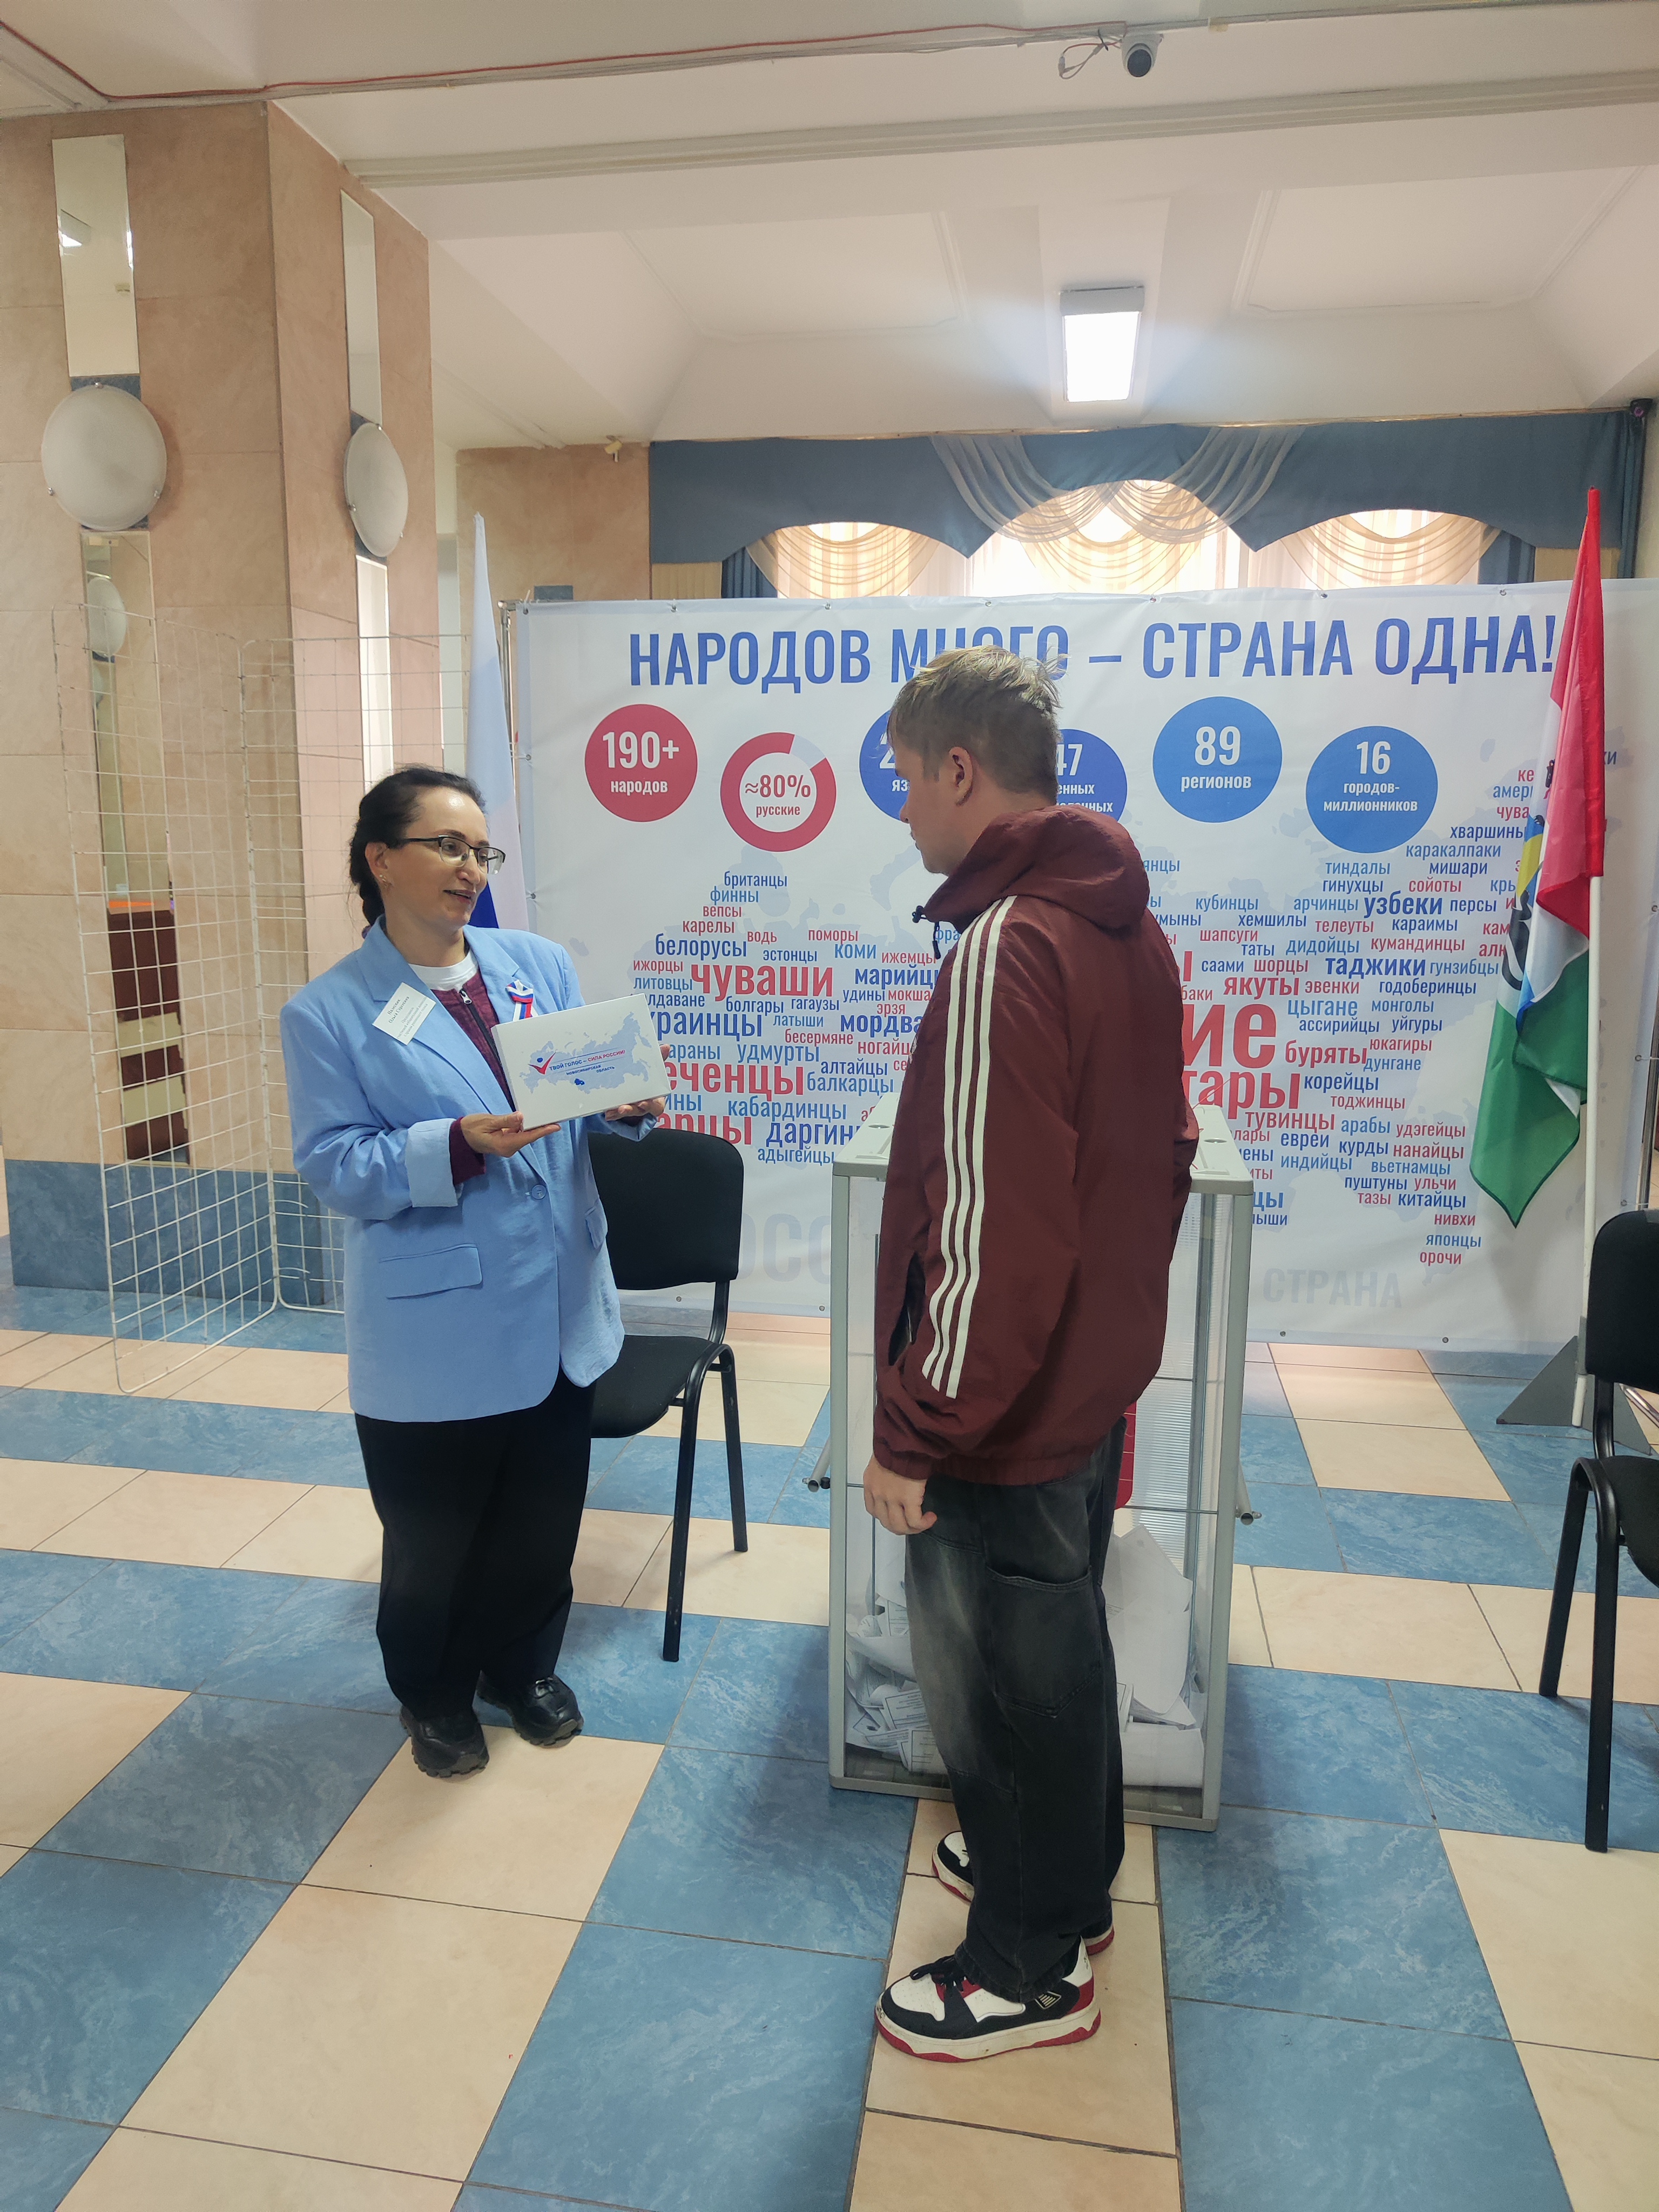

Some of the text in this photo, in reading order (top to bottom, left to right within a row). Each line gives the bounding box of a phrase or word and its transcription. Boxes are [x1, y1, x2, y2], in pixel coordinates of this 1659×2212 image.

[630, 630, 871, 693] НАРОДОВ
[1143, 619, 1353, 679] СТРАНА
[1375, 615, 1556, 685] ОДНА!
[603, 731, 679, 769] 190+
[1195, 726, 1241, 766] 89
[1356, 741, 1391, 774] 16
[611, 779, 668, 795] народов
[1057, 784, 1095, 795] енных
[1181, 773, 1252, 792] регионов
[1343, 782, 1400, 797] городов-
[756, 803, 800, 818] русские
[1323, 799, 1418, 813] миллионников
[1497, 806, 1529, 821] чува
[1406, 845, 1501, 860] каракалпаки
[1326, 862, 1391, 877] тиндалы
[1429, 862, 1487, 878] мишари
[724, 871, 787, 889] британцы
[1323, 880, 1384, 894] гинухцы
[1408, 876, 1462, 892] сойоты
[710, 886, 759, 905] финны
[1196, 894, 1258, 913] кубинцы
[703, 906, 742, 917] вепсы
[1293, 898, 1358, 913] арчинцы
[1364, 891, 1442, 918] узбеки
[1450, 899, 1496, 915] персы
[683, 920, 735, 936] карелы
[1238, 914, 1306, 927] хемшилы
[1316, 920, 1374, 935] телеуты
[1392, 919, 1458, 934] караимы
[747, 932, 777, 945] водь
[808, 929, 858, 944] поморы
[1200, 930, 1258, 944] шапсуги
[655, 933, 747, 960] белорусы
[834, 943, 876, 959] коми
[1242, 944, 1274, 956] таты
[1286, 936, 1359, 955] дидойцы
[1371, 938, 1465, 953] кумандинцы
[763, 949, 817, 964] эстонцы
[633, 960, 683, 974] ижорцы
[1202, 960, 1244, 972] саами
[1254, 959, 1309, 975] шорцы
[1326, 957, 1426, 979] таджики
[1430, 959, 1499, 976] гунзибцы
[633, 977, 692, 993] литовцы
[691, 964, 833, 1001] чуваши
[855, 965, 938, 989] марийц
[1223, 977, 1299, 1000] якуты
[1305, 980, 1359, 994] эвенки
[1379, 978, 1476, 996] годоберинцы
[647, 994, 705, 1009] лдаване
[844, 989, 885, 1003] удины
[888, 990, 931, 1001] мокша
[726, 996, 784, 1016] болгары
[791, 999, 839, 1012] гагаузы
[877, 1003, 906, 1017] эрзя
[1288, 1000, 1358, 1018] цыгане
[1371, 1000, 1434, 1013] монголы
[773, 1015, 824, 1027] латыши
[1299, 1017, 1379, 1035] ассирийцы
[1392, 1015, 1442, 1034] уйгуры
[785, 1028, 853, 1047] бесермяне
[668, 1044, 720, 1063] араны
[737, 1043, 819, 1065] удмурты
[858, 1037, 911, 1055] ногайц
[1285, 1040, 1367, 1068] буряты
[1370, 1038, 1432, 1054] юкагиры
[820, 1058, 887, 1077] алтайцы
[1363, 1058, 1421, 1072] дунгане
[664, 1062, 804, 1102] еченцы
[807, 1071, 893, 1096] балкарцы
[1304, 1072, 1379, 1093] корейцы
[1182, 1070, 1300, 1120] тары
[729, 1096, 846, 1122] кабардинцы
[1331, 1096, 1405, 1111] тоджинцы
[1245, 1111, 1334, 1134] тувинцы
[1341, 1116, 1390, 1136] арабы
[1396, 1122, 1466, 1139] удэгейцы
[766, 1122, 861, 1150] даргин
[1281, 1132, 1330, 1151] евреи
[758, 1145, 834, 1166] адыгейцы
[1339, 1141, 1388, 1157] курды
[1393, 1142, 1464, 1161] нанайцы
[1281, 1154, 1352, 1172] индийцы
[1371, 1161, 1451, 1177] вьетнамцы
[1345, 1177, 1407, 1191] пуштуны
[1414, 1178, 1456, 1191] ульчи
[1358, 1192, 1391, 1204] тазы
[1398, 1191, 1466, 1210] китайцы
[1434, 1214, 1475, 1226] нивхи
[1426, 1235, 1481, 1249] японцы
[1420, 1252, 1462, 1266] орочи
